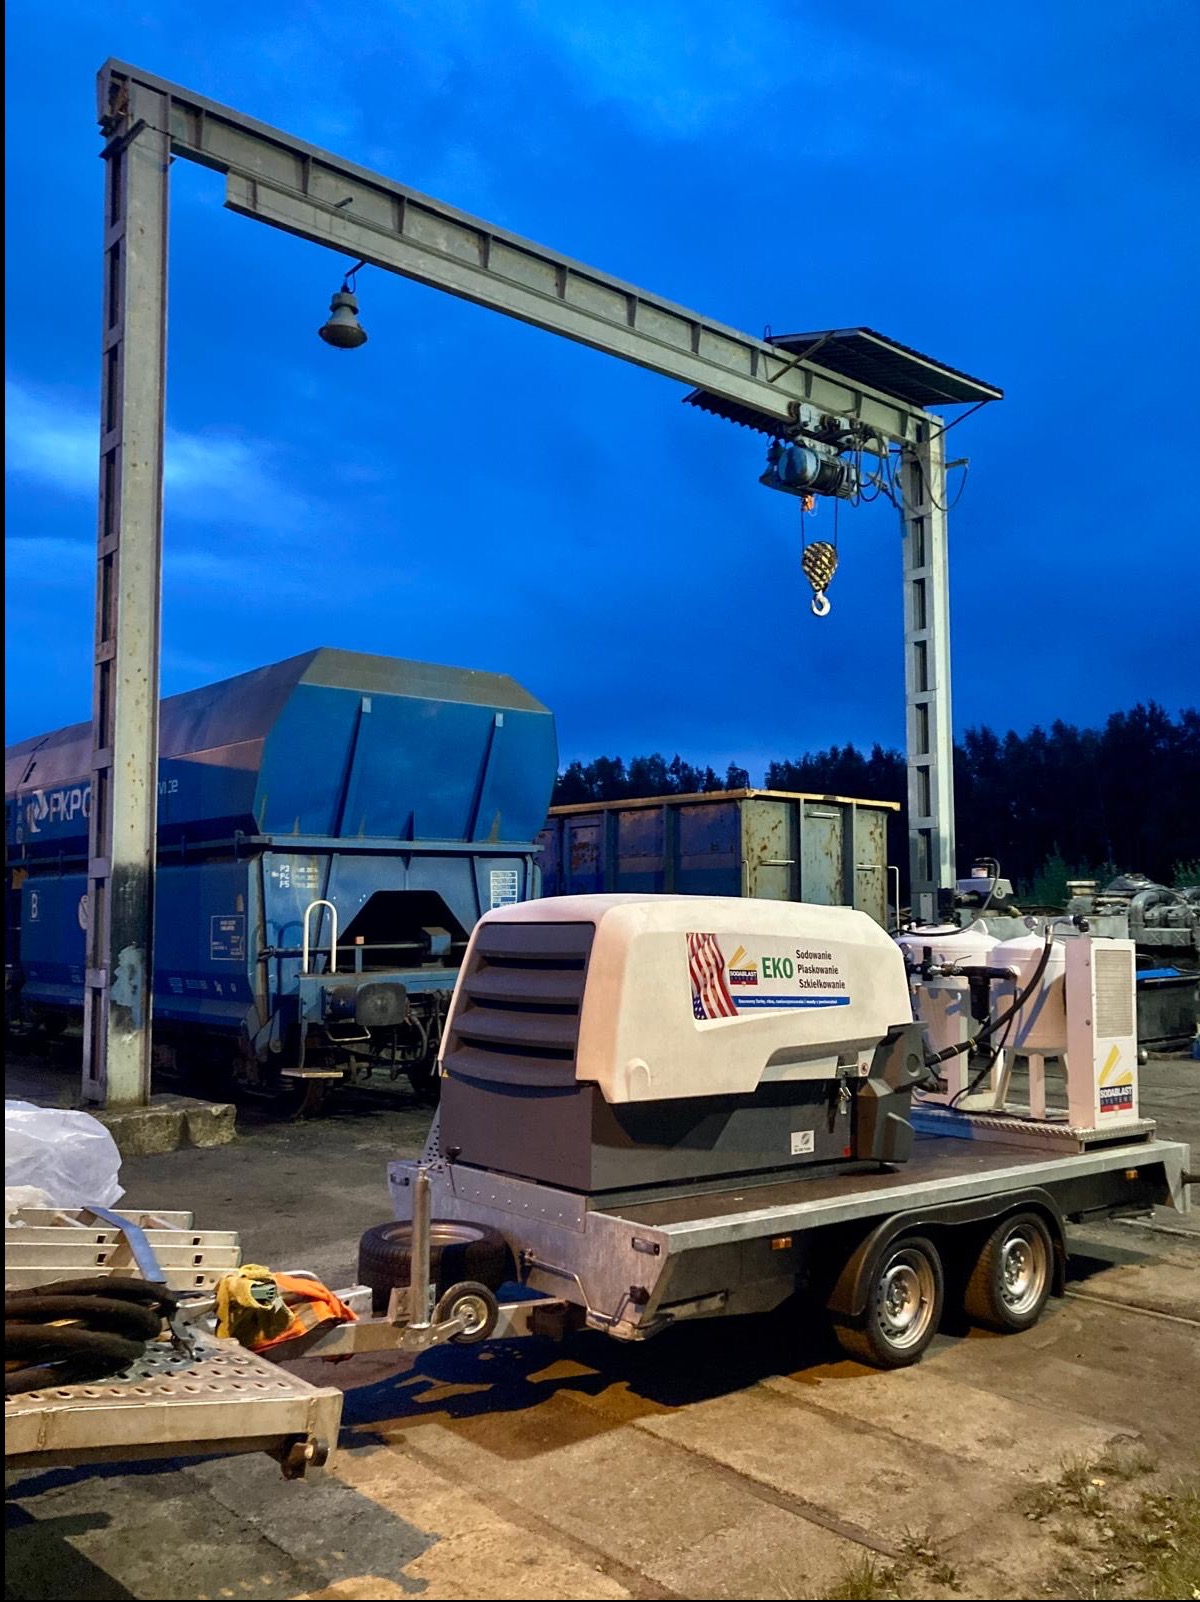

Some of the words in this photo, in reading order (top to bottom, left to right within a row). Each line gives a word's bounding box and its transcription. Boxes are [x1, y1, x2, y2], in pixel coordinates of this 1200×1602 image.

[796, 950, 832, 960] Sodowanie
[762, 957, 794, 979] EKO
[797, 964, 839, 975] Piaskowanie
[799, 978, 846, 989] Szkiełkowanie
